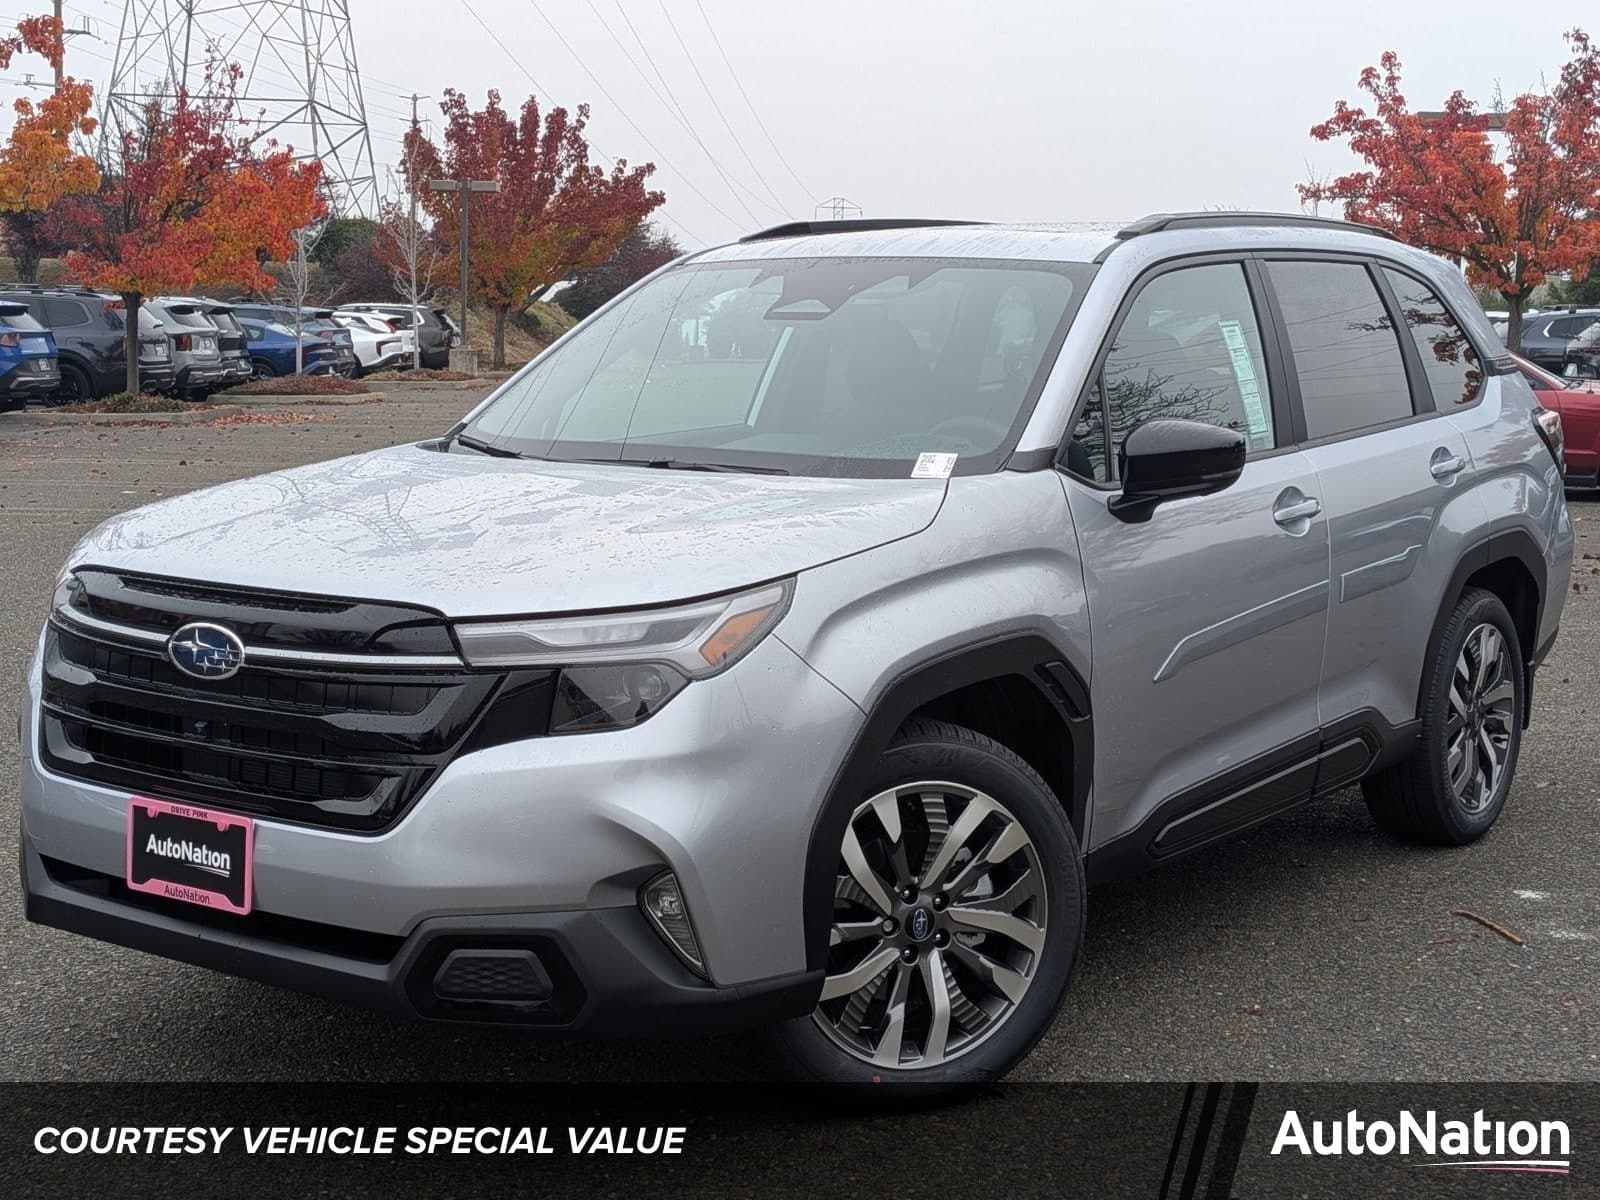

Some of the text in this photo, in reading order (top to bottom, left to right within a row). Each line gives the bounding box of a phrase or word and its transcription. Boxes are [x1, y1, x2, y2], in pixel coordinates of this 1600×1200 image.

[170, 806, 208, 819] DRIVE PINK
[145, 834, 231, 870] AutoNation
[163, 885, 210, 904] AutoNation
